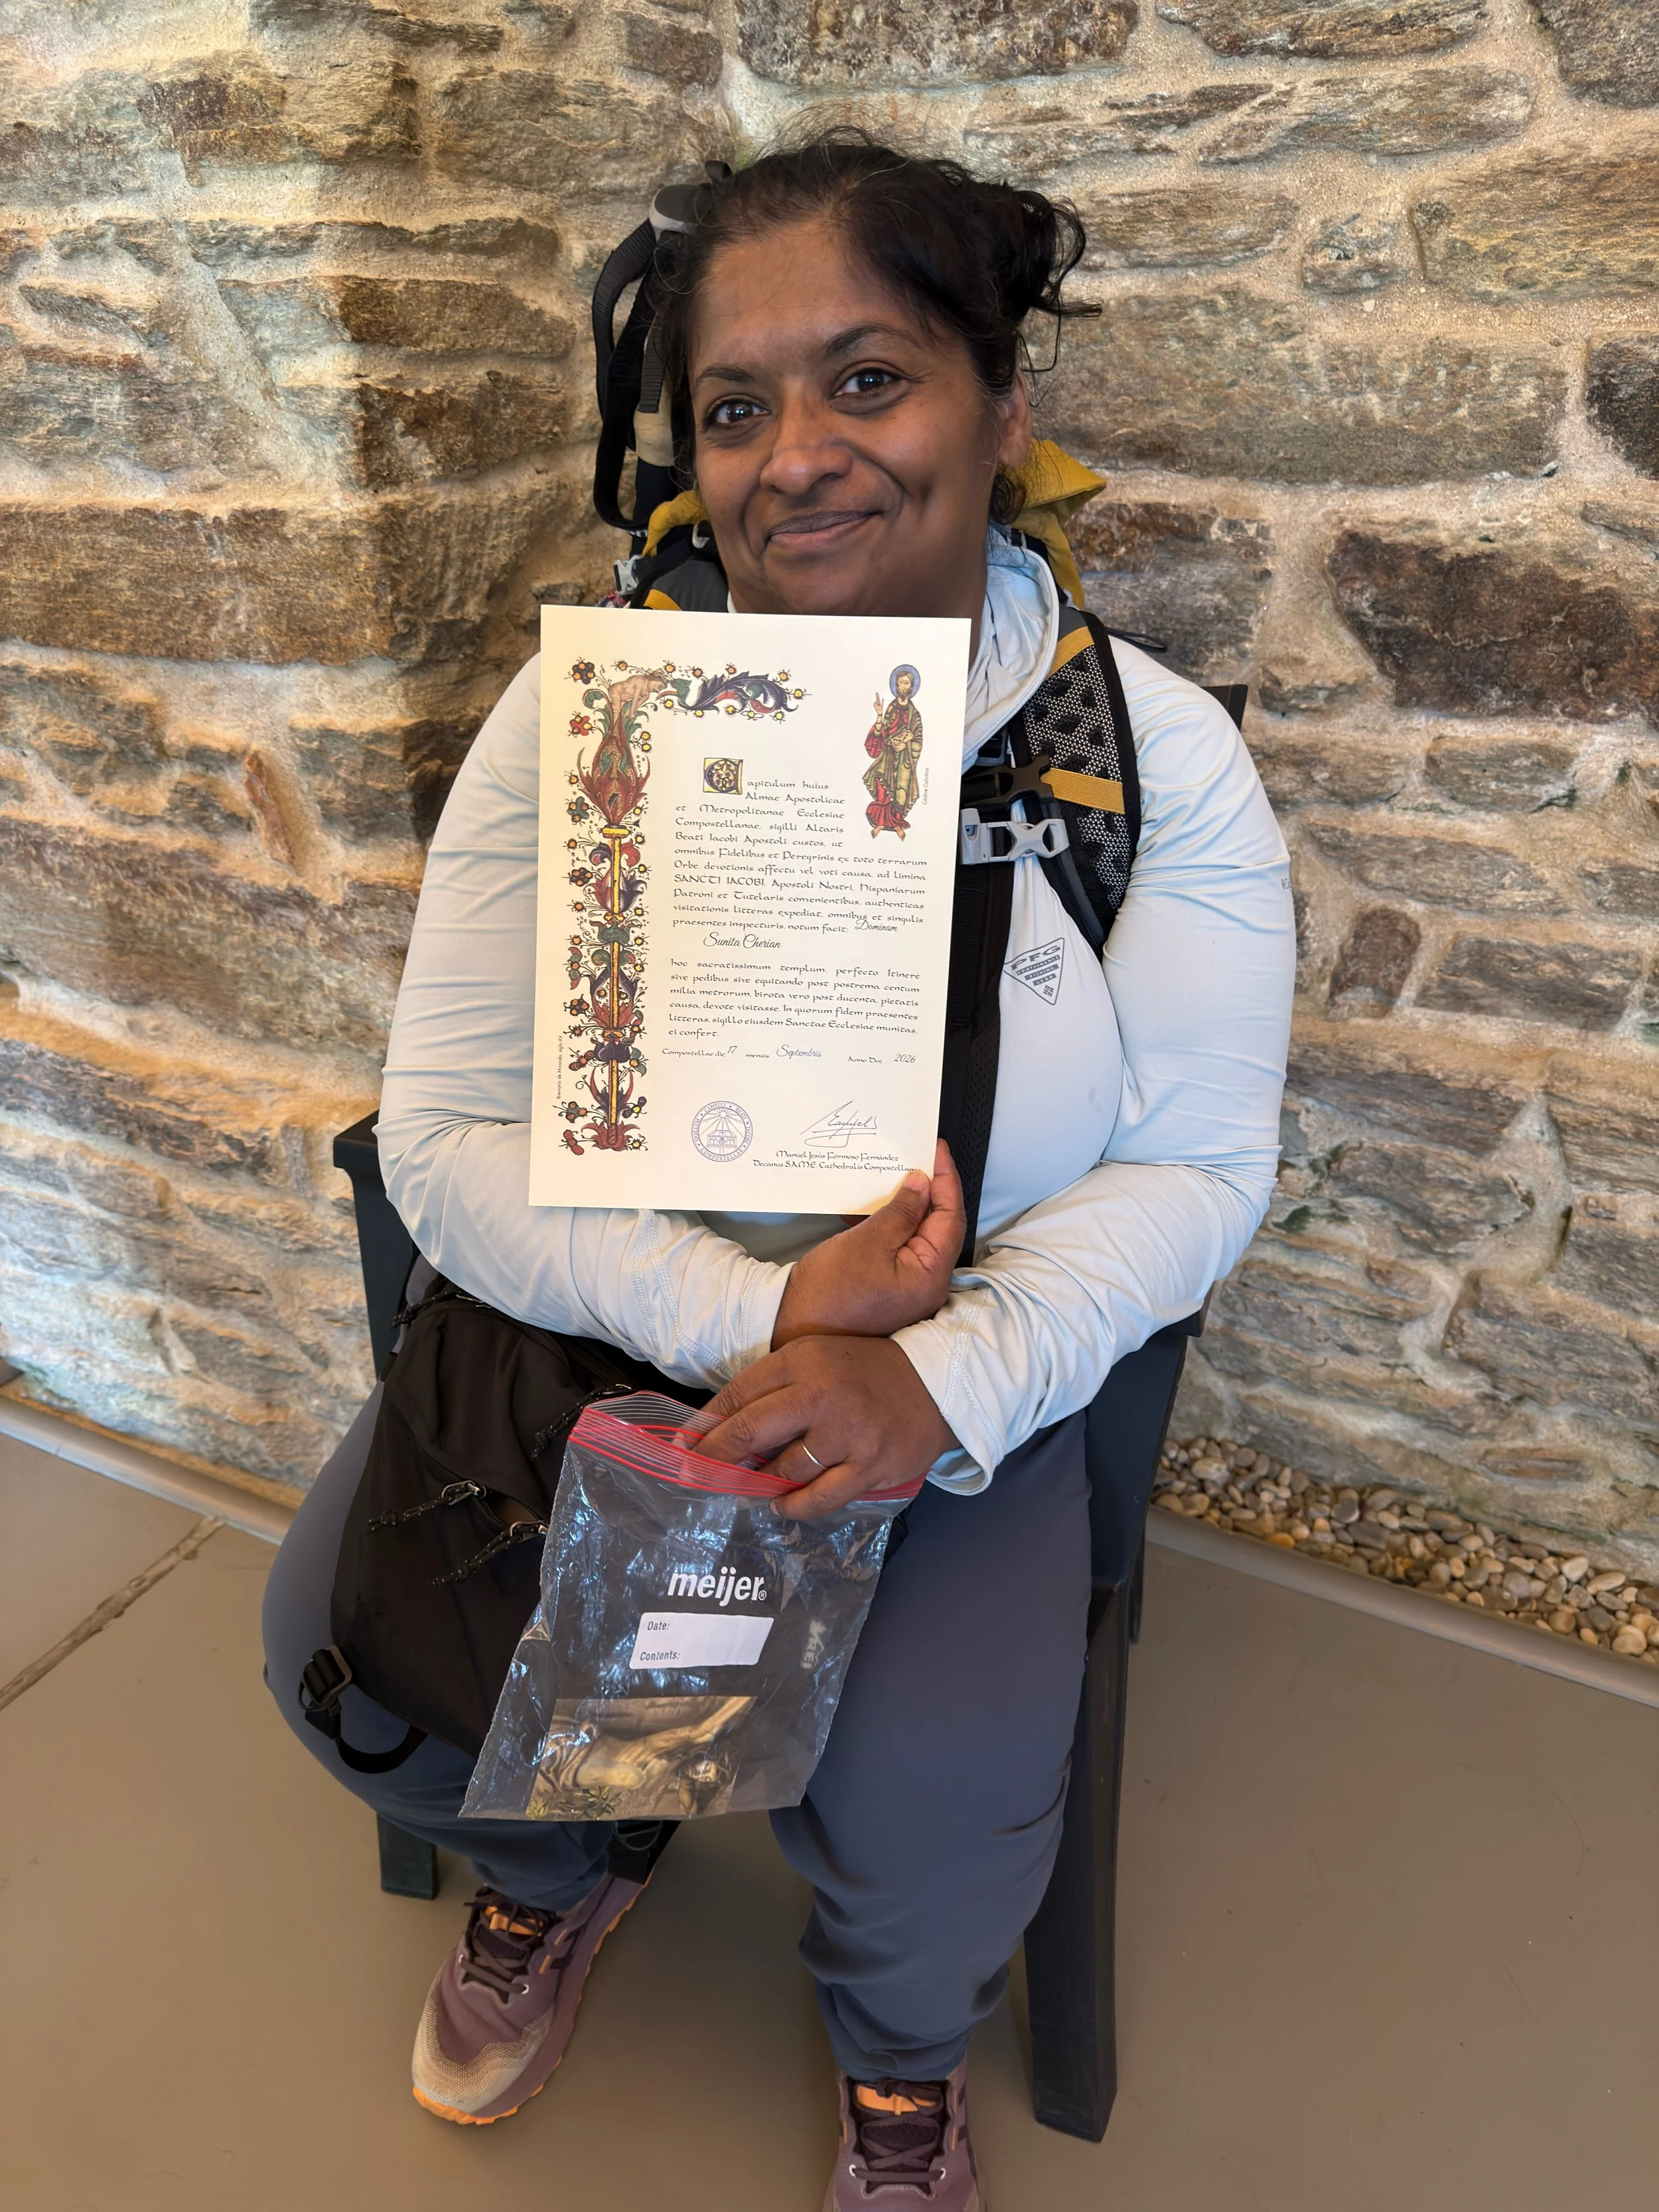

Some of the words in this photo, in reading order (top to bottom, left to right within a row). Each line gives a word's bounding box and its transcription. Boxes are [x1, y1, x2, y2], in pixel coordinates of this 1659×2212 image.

[802, 780, 829, 790] huius
[745, 792, 780, 801] Almae
[785, 794, 845, 806] Apostolicae
[699, 804, 784, 818] Metropolitanae
[797, 808, 845, 819] Ecclesiae
[769, 822, 797, 834] sigilli
[805, 824, 843, 833] Altaris
[675, 832, 703, 841] Beati
[744, 835, 787, 848] Apostoli
[674, 847, 715, 855] omnibus
[719, 848, 765, 858] Fidelibus
[782, 851, 834, 864] Peregrinis
[703, 861, 754, 871] devotionis
[758, 864, 795, 876] affectu
[894, 871, 926, 881] limina
[674, 873, 721, 884] SANCTI
[771, 879, 814, 891] Apostoli
[674, 888, 713, 898] Patroni
[733, 891, 784, 901] Tutelaris
[865, 899, 924, 909] authenticas
[733, 905, 774, 915] litteras
[828, 911, 867, 920] omnibus
[887, 915, 924, 926] singulis
[822, 923, 849, 934] facit:
[855, 919, 899, 932] Dominam
[703, 931, 741, 947] Sunita
[743, 934, 781, 949] Cherian
[1010, 945, 1060, 970] PFG
[835, 966, 879, 978] perfecto
[1017, 955, 1060, 976] PERFORMANCE
[1029, 966, 1055, 978] FISHING
[693, 974, 729, 985] pedibus
[755, 978, 804, 988] equitando
[1035, 975, 1054, 985] GEAR
[754, 990, 786, 998] birota
[881, 998, 918, 1007] pietatis
[703, 1001, 735, 1010] devote
[835, 1007, 863, 1018] fidem
[865, 1011, 918, 1020] praesentes
[712, 1015, 743, 1027] sigillo
[785, 1018, 827, 1027] Sanctae
[828, 1020, 875, 1030] Ecclesiae
[662, 1048, 714, 1058] Compostellae
[727, 1045, 738, 1054] 17
[776, 1044, 822, 1059] Septembris
[894, 1053, 916, 1063] 2026
[701, 1148, 743, 1161] COMPOSTELLAE
[753, 1159, 784, 1167] Decanus
[818, 1161, 863, 1170] Cathedralis
[647, 1621, 670, 1631] Date:
[640, 1651, 680, 1661] Contents:
